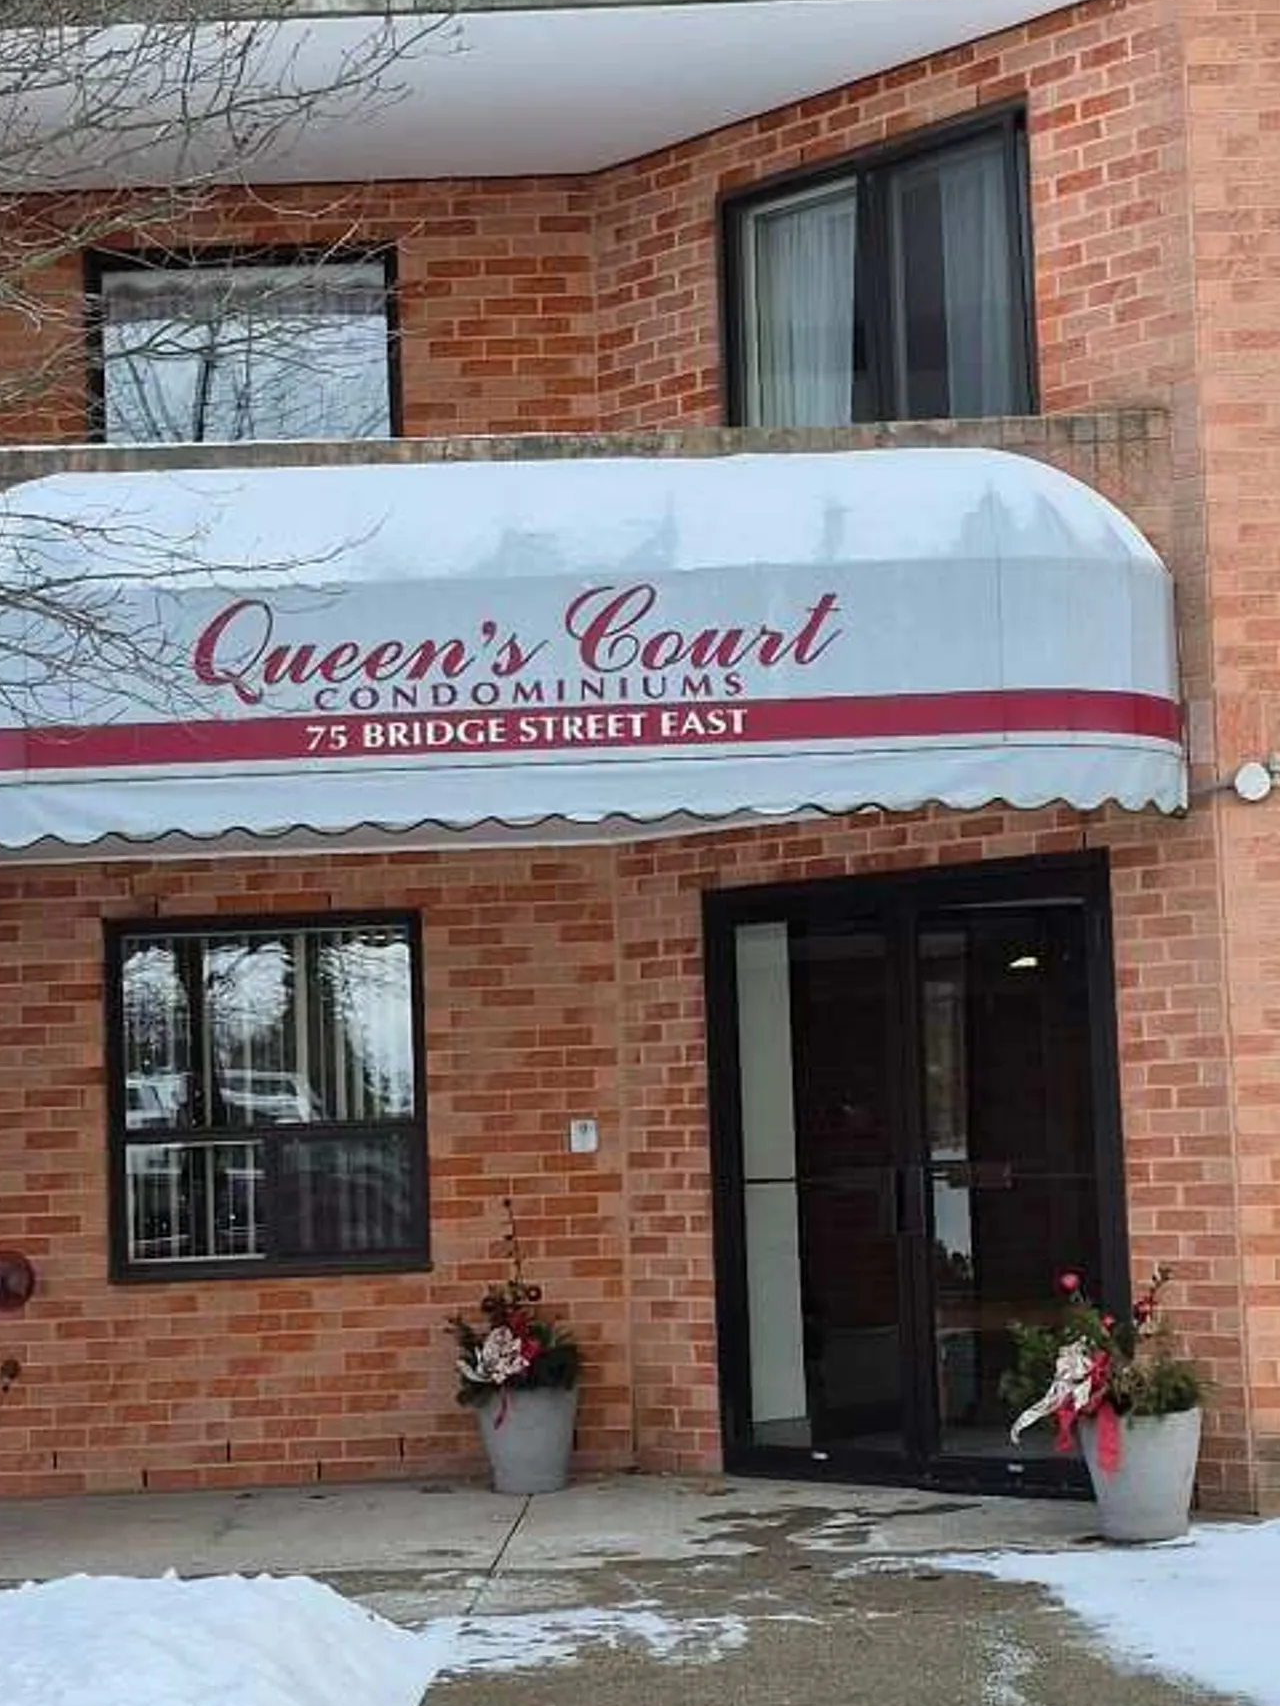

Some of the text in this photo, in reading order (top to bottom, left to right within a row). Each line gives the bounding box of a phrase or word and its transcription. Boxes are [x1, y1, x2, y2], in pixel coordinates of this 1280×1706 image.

[194, 583, 843, 705] Queen's Court
[314, 672, 745, 711] CONDOMINIUMS
[305, 708, 749, 750] 75 BRIDGE STREET EAST
